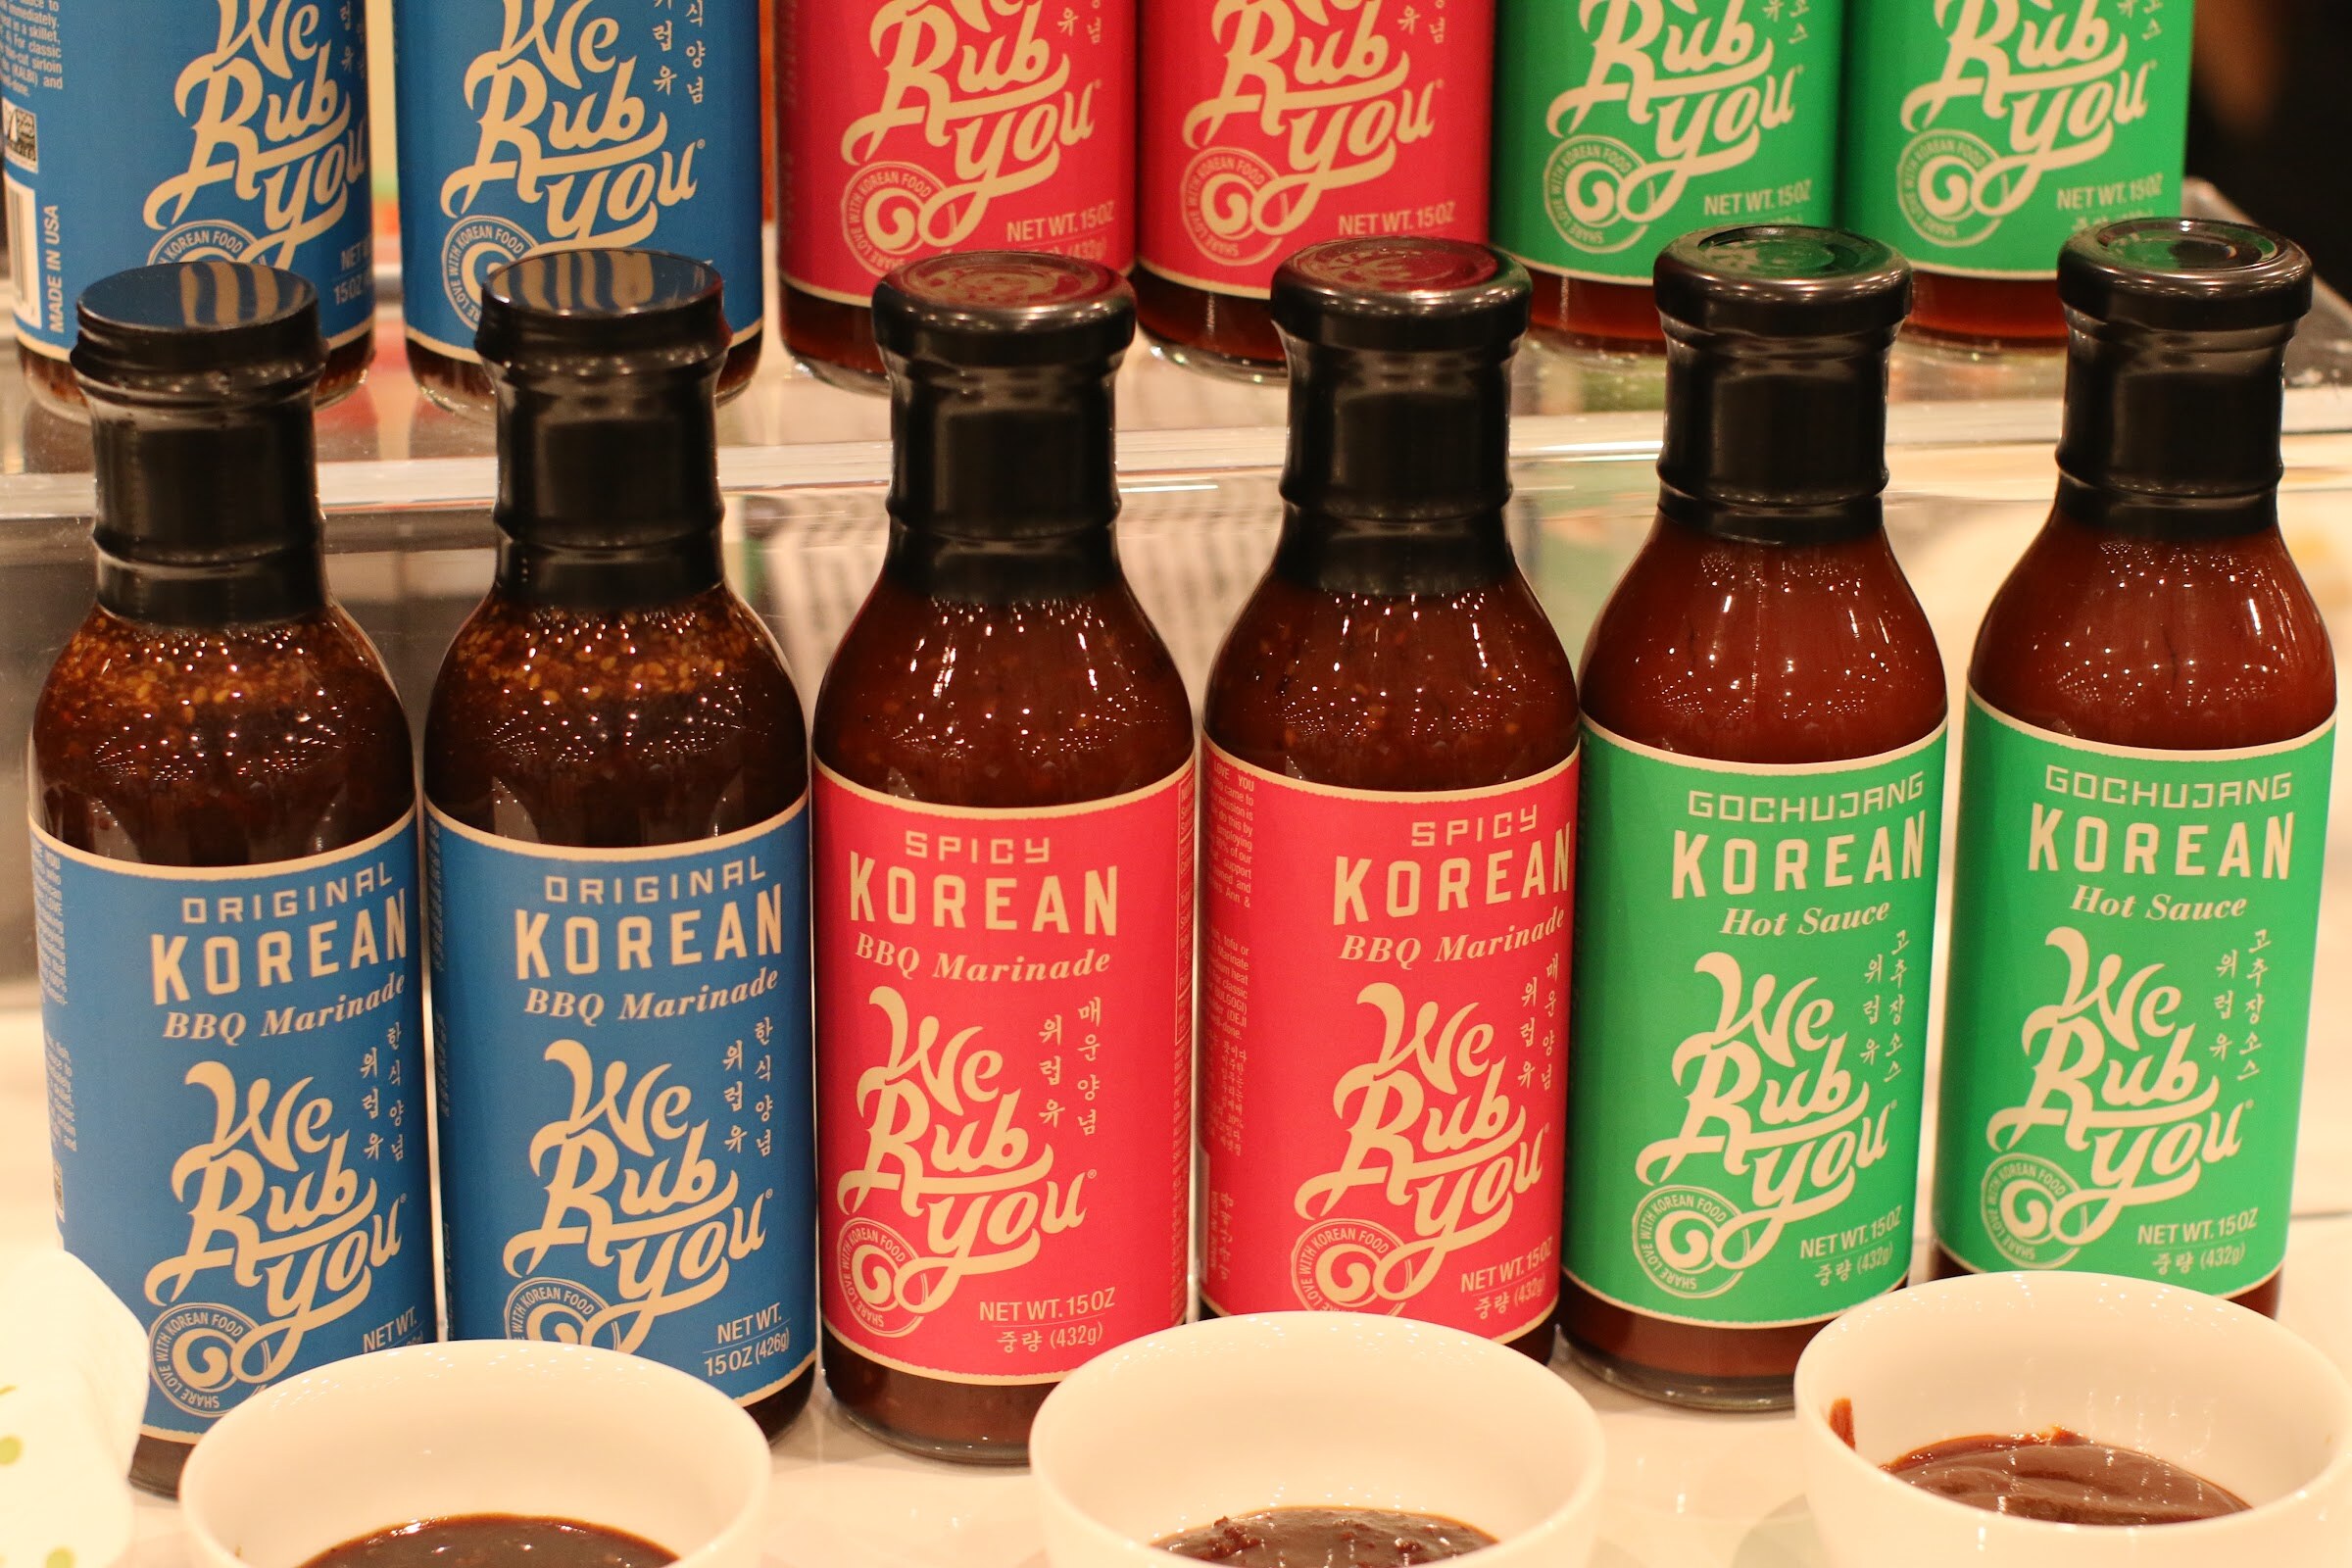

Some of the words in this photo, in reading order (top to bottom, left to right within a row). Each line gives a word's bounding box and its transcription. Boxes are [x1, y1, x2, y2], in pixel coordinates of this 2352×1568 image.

[500, 0, 619, 90] We
[1900, 0, 2128, 132] Rub
[840, 0, 1070, 166] Rub
[1182, 0, 1409, 149] Rub
[1545, 0, 1774, 137] Rub
[142, 39, 350, 230] Rub
[440, 56, 667, 219] Rub
[1704, 192, 1742, 216] NET
[2056, 186, 2096, 210] NET
[43, 205, 61, 246] USA
[456, 225, 493, 249] KOREAN
[495, 228, 524, 254] FOOD
[1006, 218, 1045, 243] NET
[1048, 213, 1078, 236] WT.
[1339, 213, 1380, 236] NET
[1381, 209, 1414, 233] WT.
[46, 249, 62, 271] IN
[164, 230, 209, 260] KOREAN
[213, 230, 243, 254] FOOD
[449, 245, 462, 276] WITH
[47, 275, 65, 333] MADE
[451, 279, 469, 309] LOVE
[1238, 774, 1254, 792] YOU
[1688, 770, 1924, 823] GOCHUJANG
[2045, 764, 2292, 808] GOCHUJANG
[906, 830, 1050, 864] SPICY
[1411, 804, 1538, 847] SPICY
[2028, 802, 2295, 881] KOREAN
[1333, 821, 1570, 925] KOREAN
[1672, 809, 1926, 900] KOREAN
[182, 862, 392, 923] ORIGINAL
[545, 856, 765, 904] ORIGINAL
[850, 851, 1117, 937] KOREAN
[1719, 907, 1788, 936] Hot
[1797, 902, 1889, 935] Sauce
[2070, 884, 2136, 918] Hot
[2145, 894, 2247, 921] Sauce
[150, 888, 407, 1005] KOREAN
[514, 883, 782, 980] KOREAN
[1339, 934, 1421, 970] BBQ
[1434, 906, 1564, 962] Marinade
[855, 932, 921, 979] BBQ
[932, 949, 1110, 982] Marinade
[163, 1011, 247, 1046] BBQ
[260, 972, 405, 1038] Marinade
[524, 987, 605, 1026] BBQ
[618, 966, 778, 1020] Marinade
[1694, 951, 1834, 1068] We
[2045, 926, 2181, 1052] We
[869, 986, 1003, 1115] We
[1356, 982, 1494, 1095] We
[544, 1039, 692, 1156] We
[1635, 1031, 1870, 1186] Rub
[1986, 1023, 2220, 1152] Rub
[184, 1060, 333, 1171] We
[1294, 1055, 1526, 1220] Rub
[837, 1088, 1054, 1216] Rub
[503, 1119, 738, 1277] Rub
[2038, 1169, 2065, 1196] FOOD
[144, 1129, 377, 1306] Rub
[848, 1228, 878, 1247] KOREAN
[1311, 1228, 1356, 1250] KOREAN
[1641, 1213, 1656, 1240] WITH
[1651, 1195, 1694, 1215] KOREAN
[1697, 1198, 1727, 1223] FOOD
[2137, 1225, 2178, 1247] NET
[2181, 1221, 2214, 1242] WT.
[880, 1235, 906, 1262] FOOD
[1299, 1246, 1316, 1274] WITH
[1358, 1230, 1389, 1254] FOOD
[1800, 1235, 1838, 1259] NET
[1841, 1227, 1868, 1251] WT.
[1300, 1278, 1323, 1306] LOVE
[1460, 1266, 1497, 1294] NET
[1499, 1257, 1525, 1283] WT.
[165, 1312, 208, 1336] KOREAN
[212, 1313, 243, 1337] FOOD
[363, 1321, 394, 1352] NET
[396, 1306, 416, 1336] WT.
[512, 1304, 526, 1333] WITH
[520, 1287, 561, 1307] KOREAN
[564, 1290, 595, 1315] FOOD
[717, 1315, 752, 1344] NET
[756, 1302, 782, 1331] WT.
[856, 1300, 884, 1327] SHARE
[980, 1301, 1019, 1322] NET
[1026, 1298, 1063, 1319] WT.
[157, 1332, 172, 1361] WITH
[755, 1327, 789, 1365] (426g)
[1050, 1322, 1103, 1349] (432g)
[159, 1365, 182, 1393] LOVE
[180, 1389, 220, 1408] SHARE
